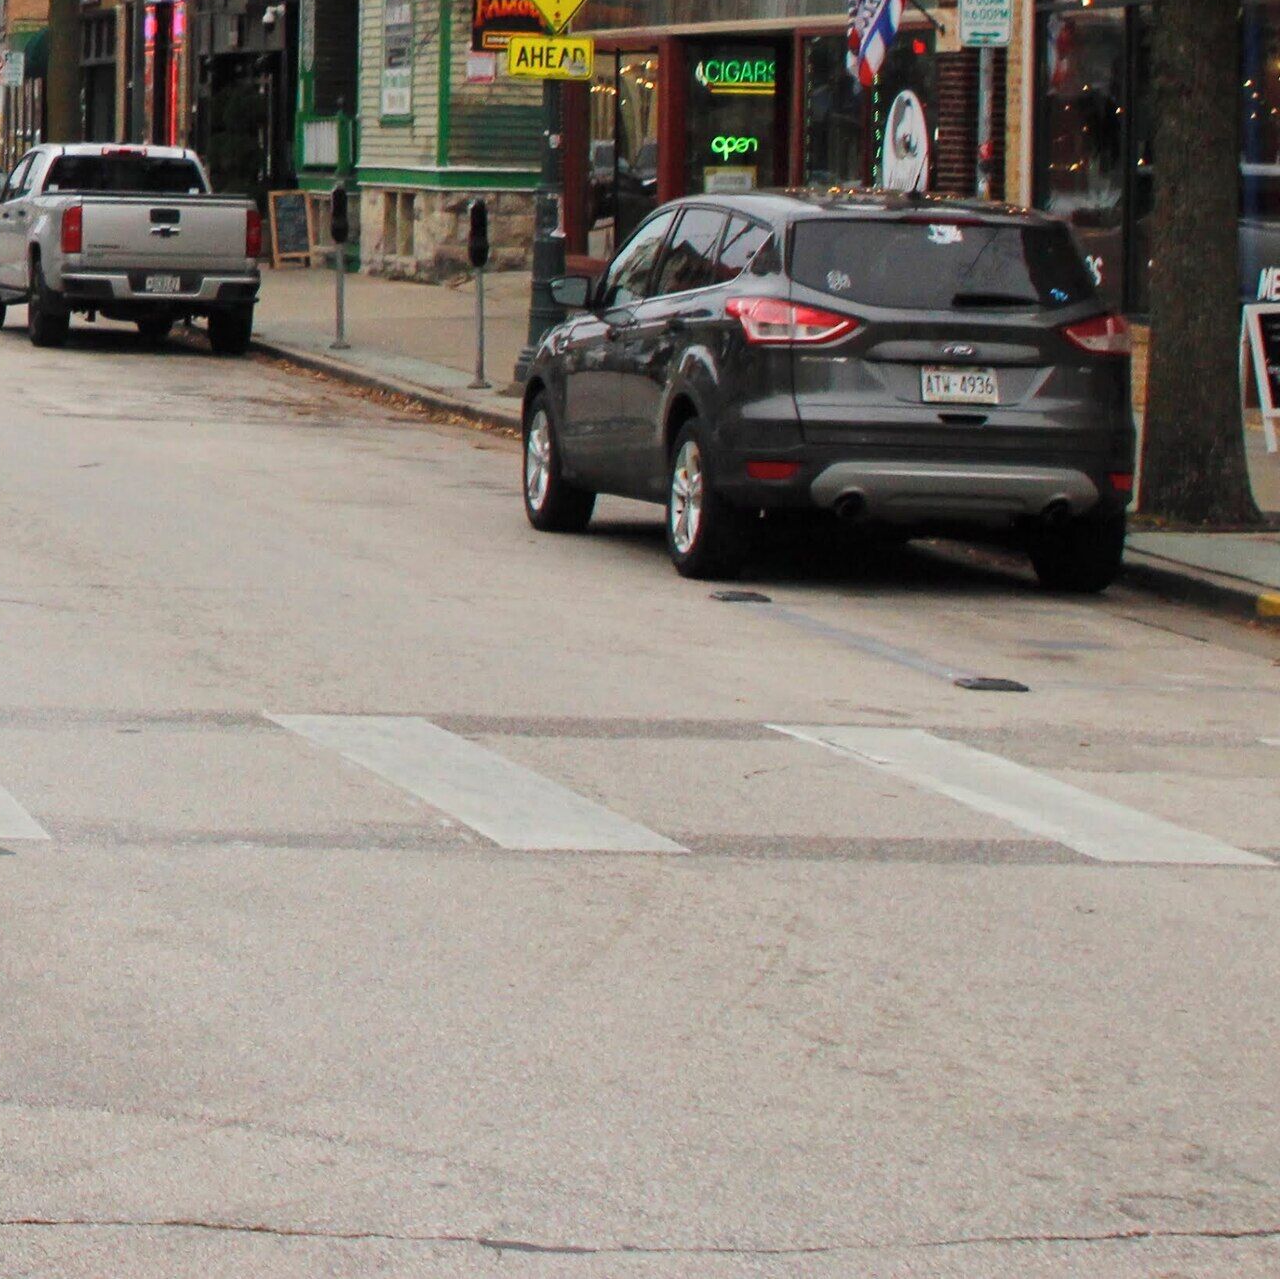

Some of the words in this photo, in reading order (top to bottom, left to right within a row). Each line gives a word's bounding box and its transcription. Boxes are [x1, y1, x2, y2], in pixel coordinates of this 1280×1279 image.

[516, 45, 586, 69] AHEAD
[711, 136, 758, 161] open
[926, 374, 994, 395] ATW-4936
